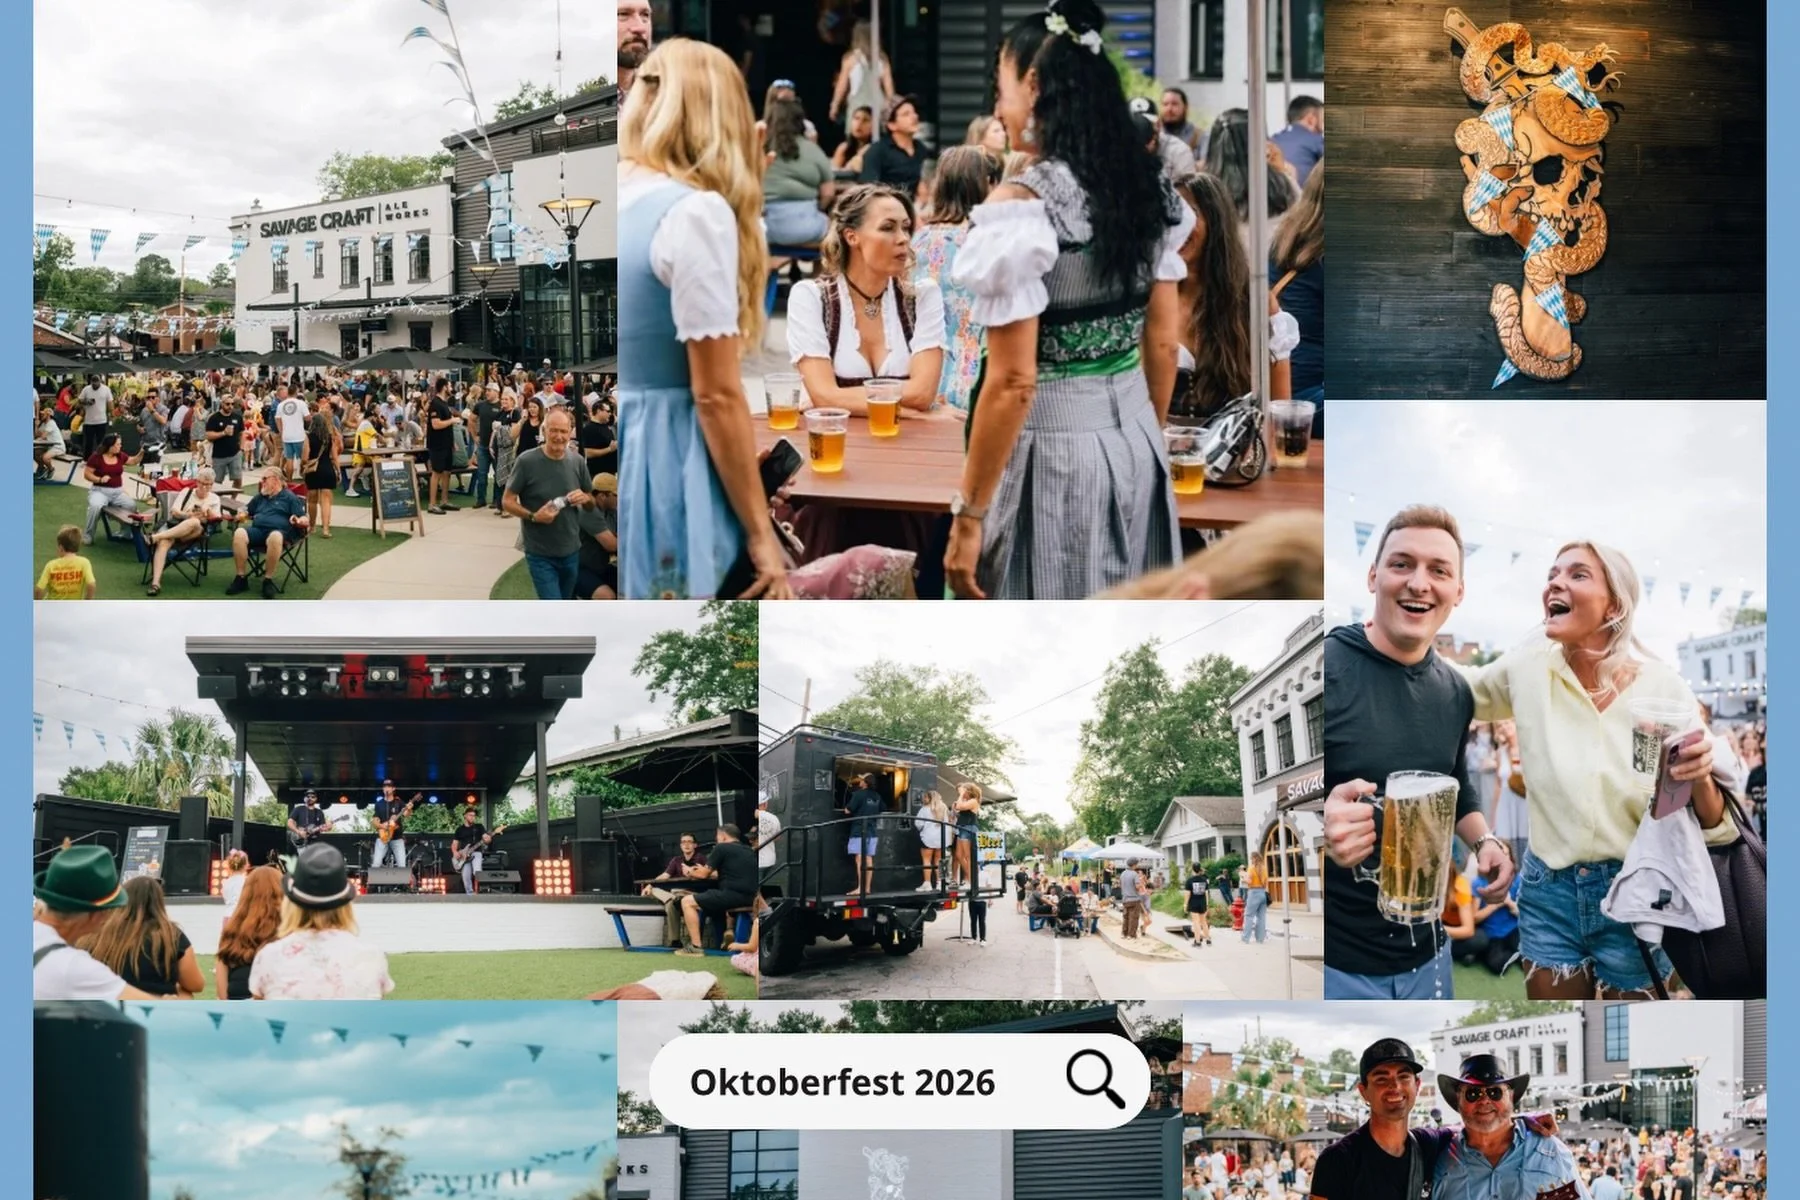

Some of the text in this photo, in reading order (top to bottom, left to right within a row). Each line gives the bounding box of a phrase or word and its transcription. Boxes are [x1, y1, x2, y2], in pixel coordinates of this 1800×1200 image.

[385, 201, 408, 211] ALE
[385, 208, 429, 221] WORKS
[260, 206, 375, 238] SAVAGE CRAFT
[1647, 735, 1658, 775] SAVAGE
[1451, 1026, 1530, 1046] SAVAGE CRAFT
